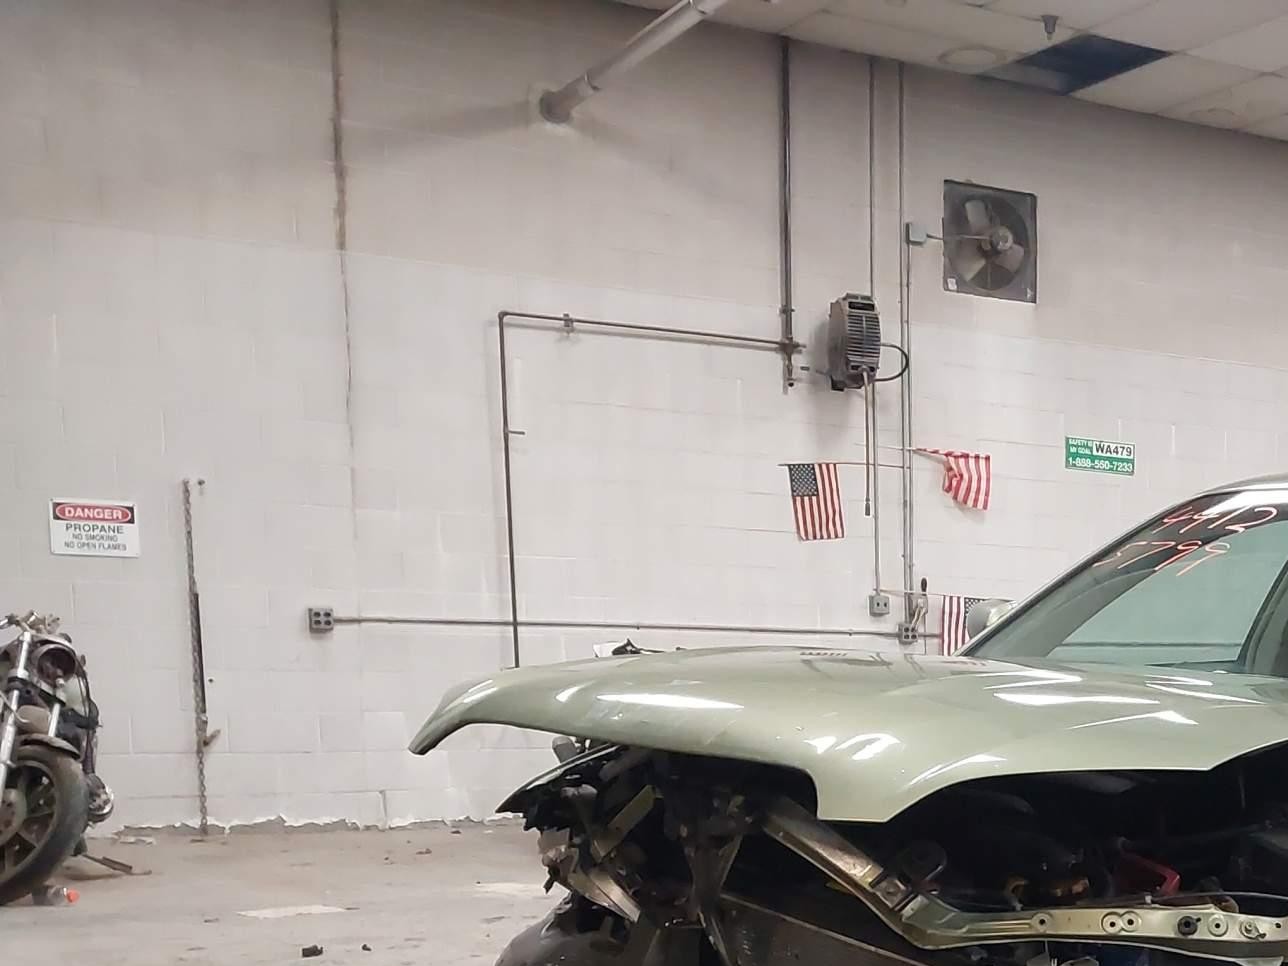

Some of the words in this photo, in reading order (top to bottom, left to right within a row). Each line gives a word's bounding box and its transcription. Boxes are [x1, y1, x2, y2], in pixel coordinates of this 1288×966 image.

[1095, 443, 1132, 456] WA479
[64, 506, 123, 520] DANGER
[65, 523, 124, 534] PROPANE
[72, 533, 83, 541] NO
[85, 534, 118, 542] SMOKING
[64, 541, 75, 549] NO
[98, 543, 127, 551] FLAMES
